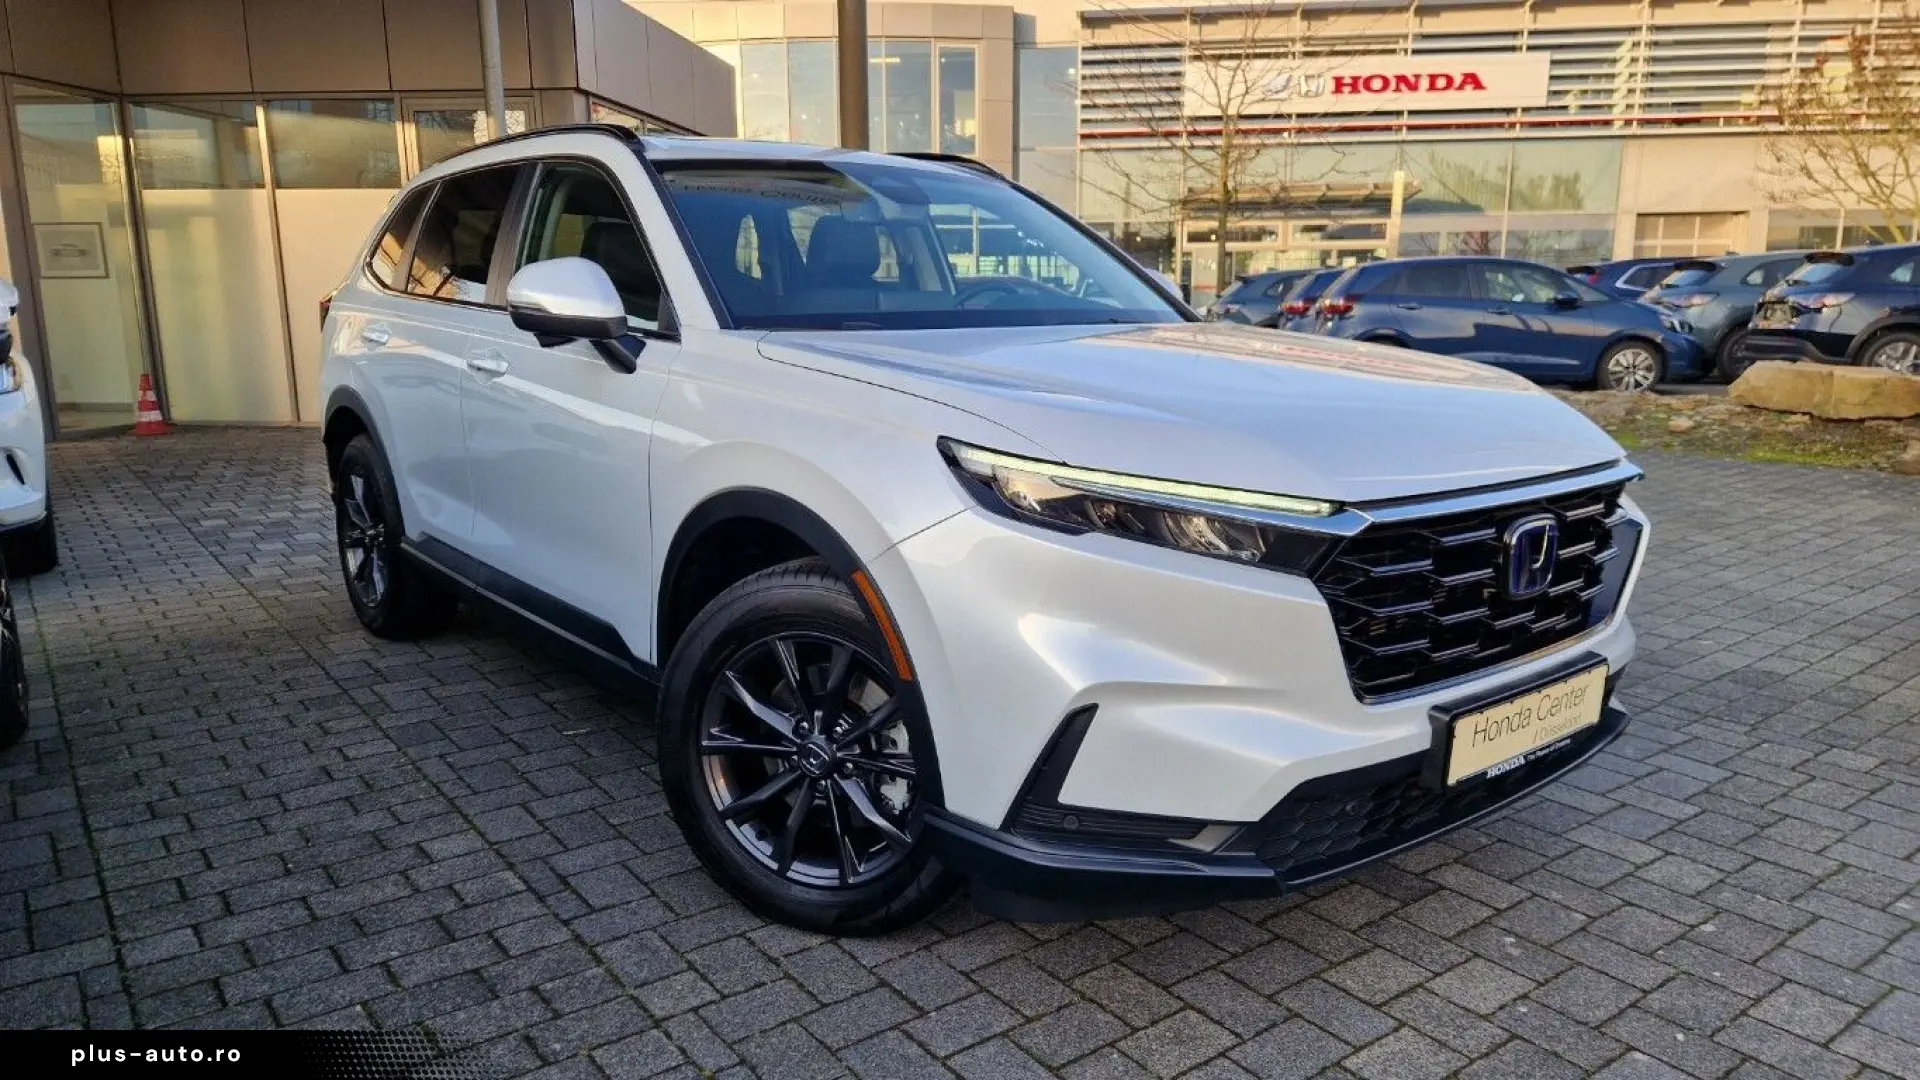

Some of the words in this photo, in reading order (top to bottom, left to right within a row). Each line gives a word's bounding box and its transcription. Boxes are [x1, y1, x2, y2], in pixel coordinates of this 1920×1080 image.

[1331, 72, 1487, 94] HONDA
[1472, 704, 1532, 747] Honda
[1537, 684, 1591, 721] Center
[1486, 754, 1526, 779] HONDA
